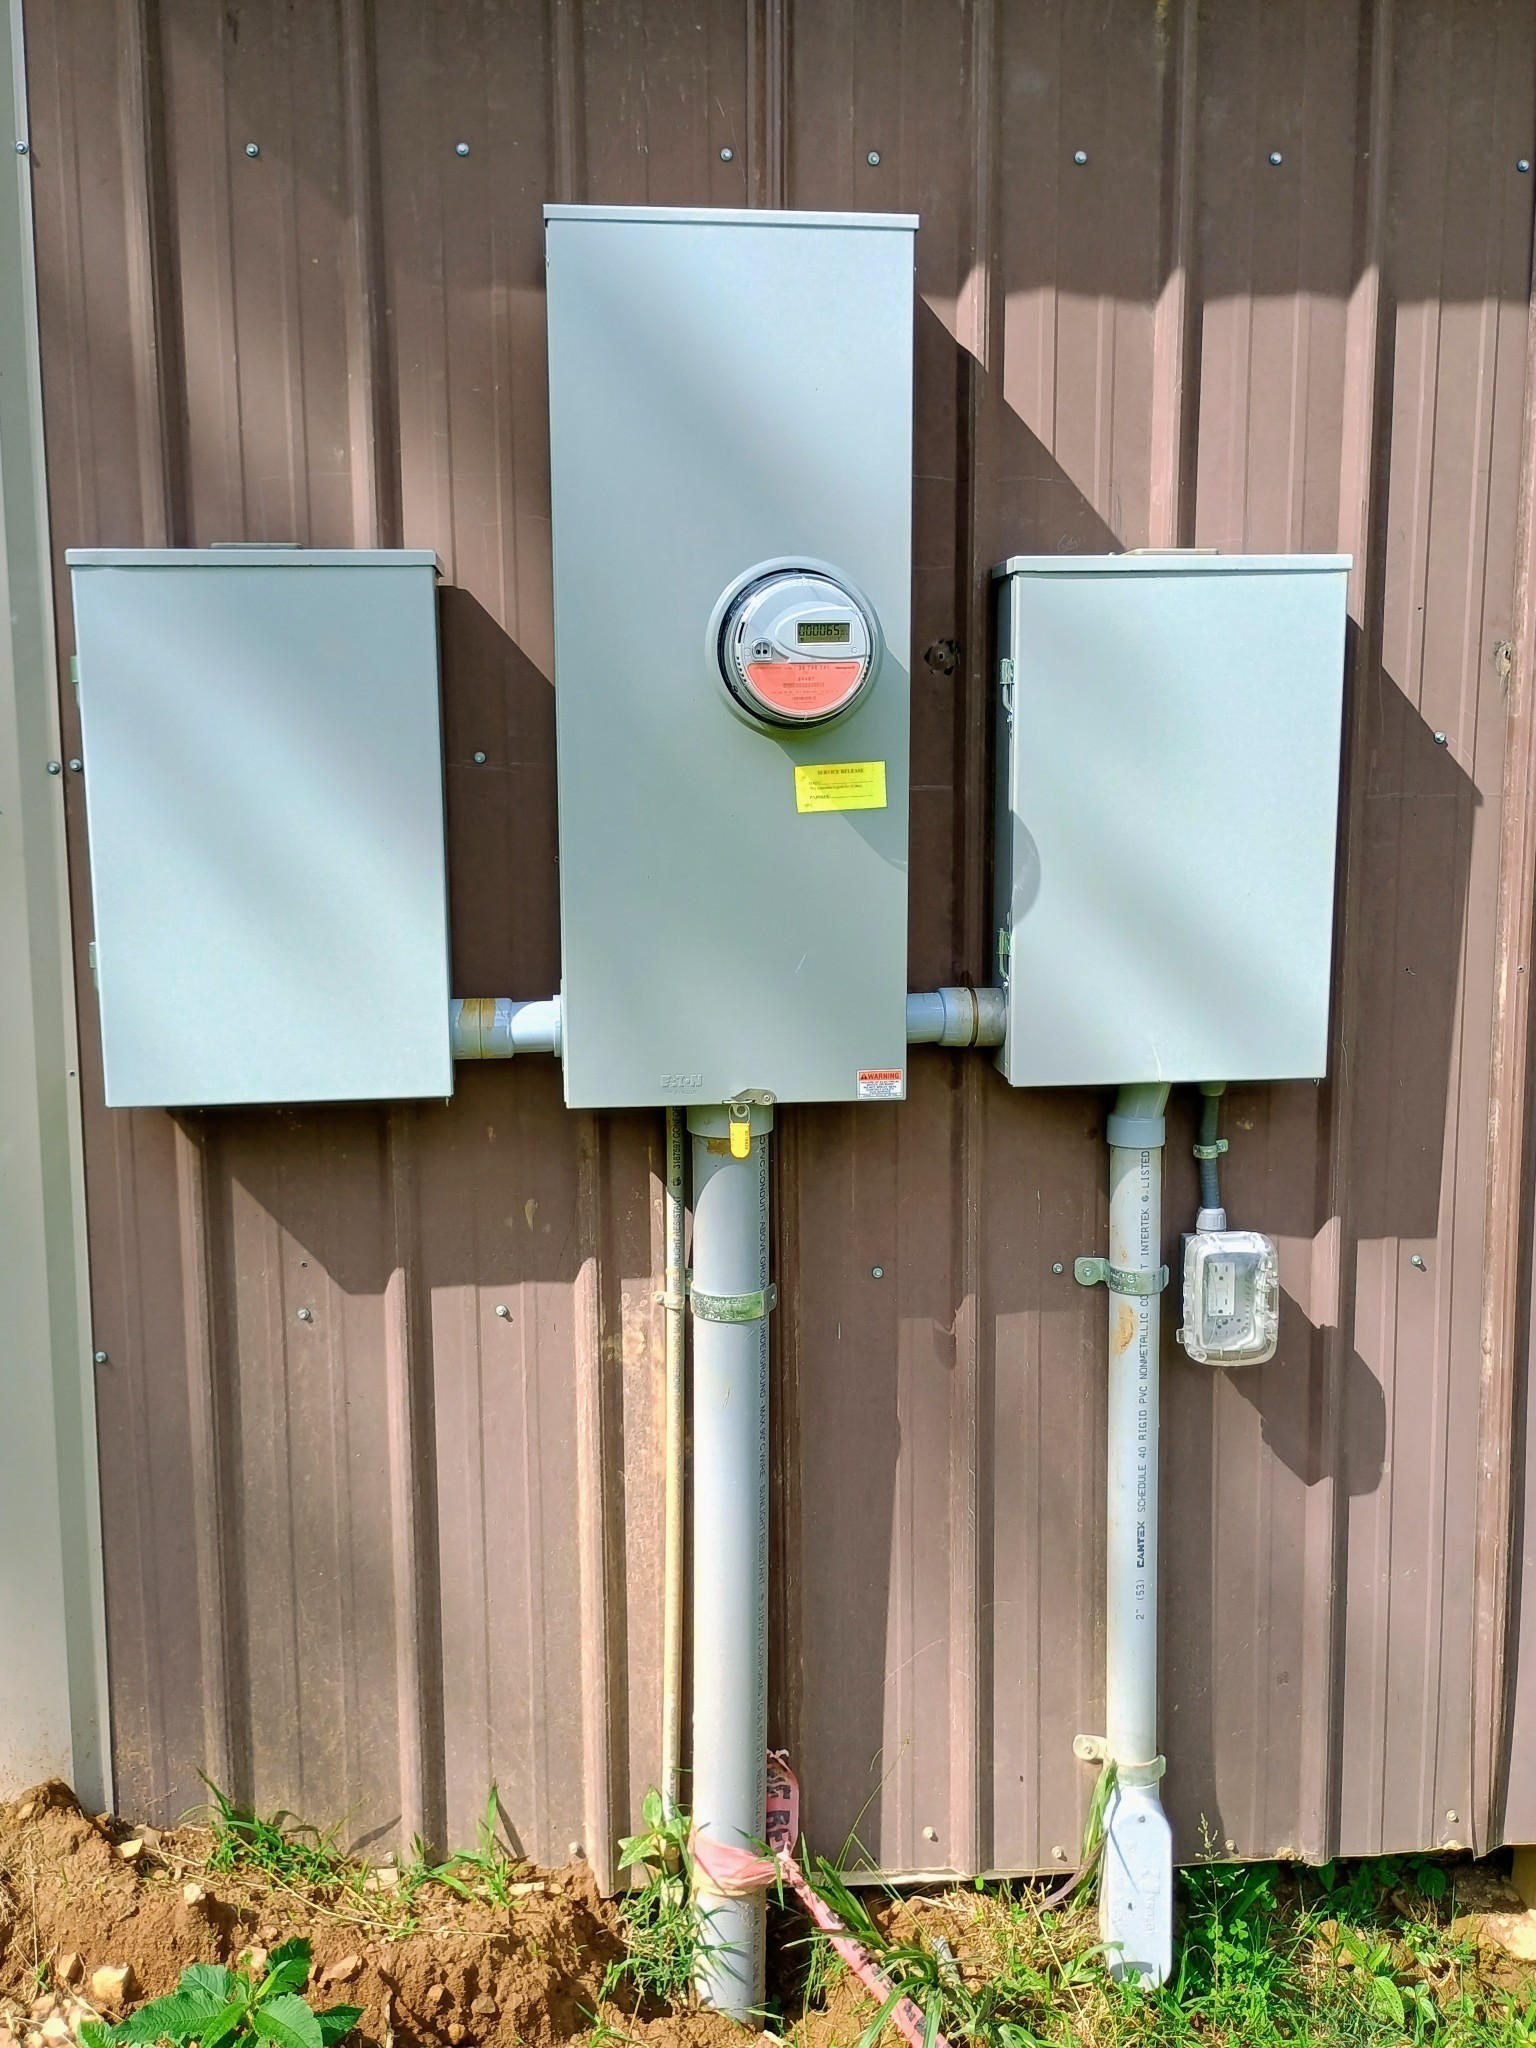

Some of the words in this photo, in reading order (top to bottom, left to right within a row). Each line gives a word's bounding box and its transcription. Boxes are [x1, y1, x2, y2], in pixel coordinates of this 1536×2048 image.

[867, 1072, 900, 1080] WARNING
[673, 1196, 681, 1237] RESISTANT
[1140, 1208, 1149, 1256] INTERTEK
[1139, 1312, 1149, 1380] NONMETALLIC
[1139, 1385, 1148, 1404] PVC
[1138, 1409, 1148, 1441] RIGID
[1138, 1446, 1147, 1459] 40
[758, 1485, 766, 1532] SUNLIGHT
[1137, 1464, 1147, 1513] SCHEDULE
[758, 1534, 766, 1586] RESISTANT
[1136, 1521, 1146, 1568] CANTEX
[1135, 1579, 1145, 1601] (53)
